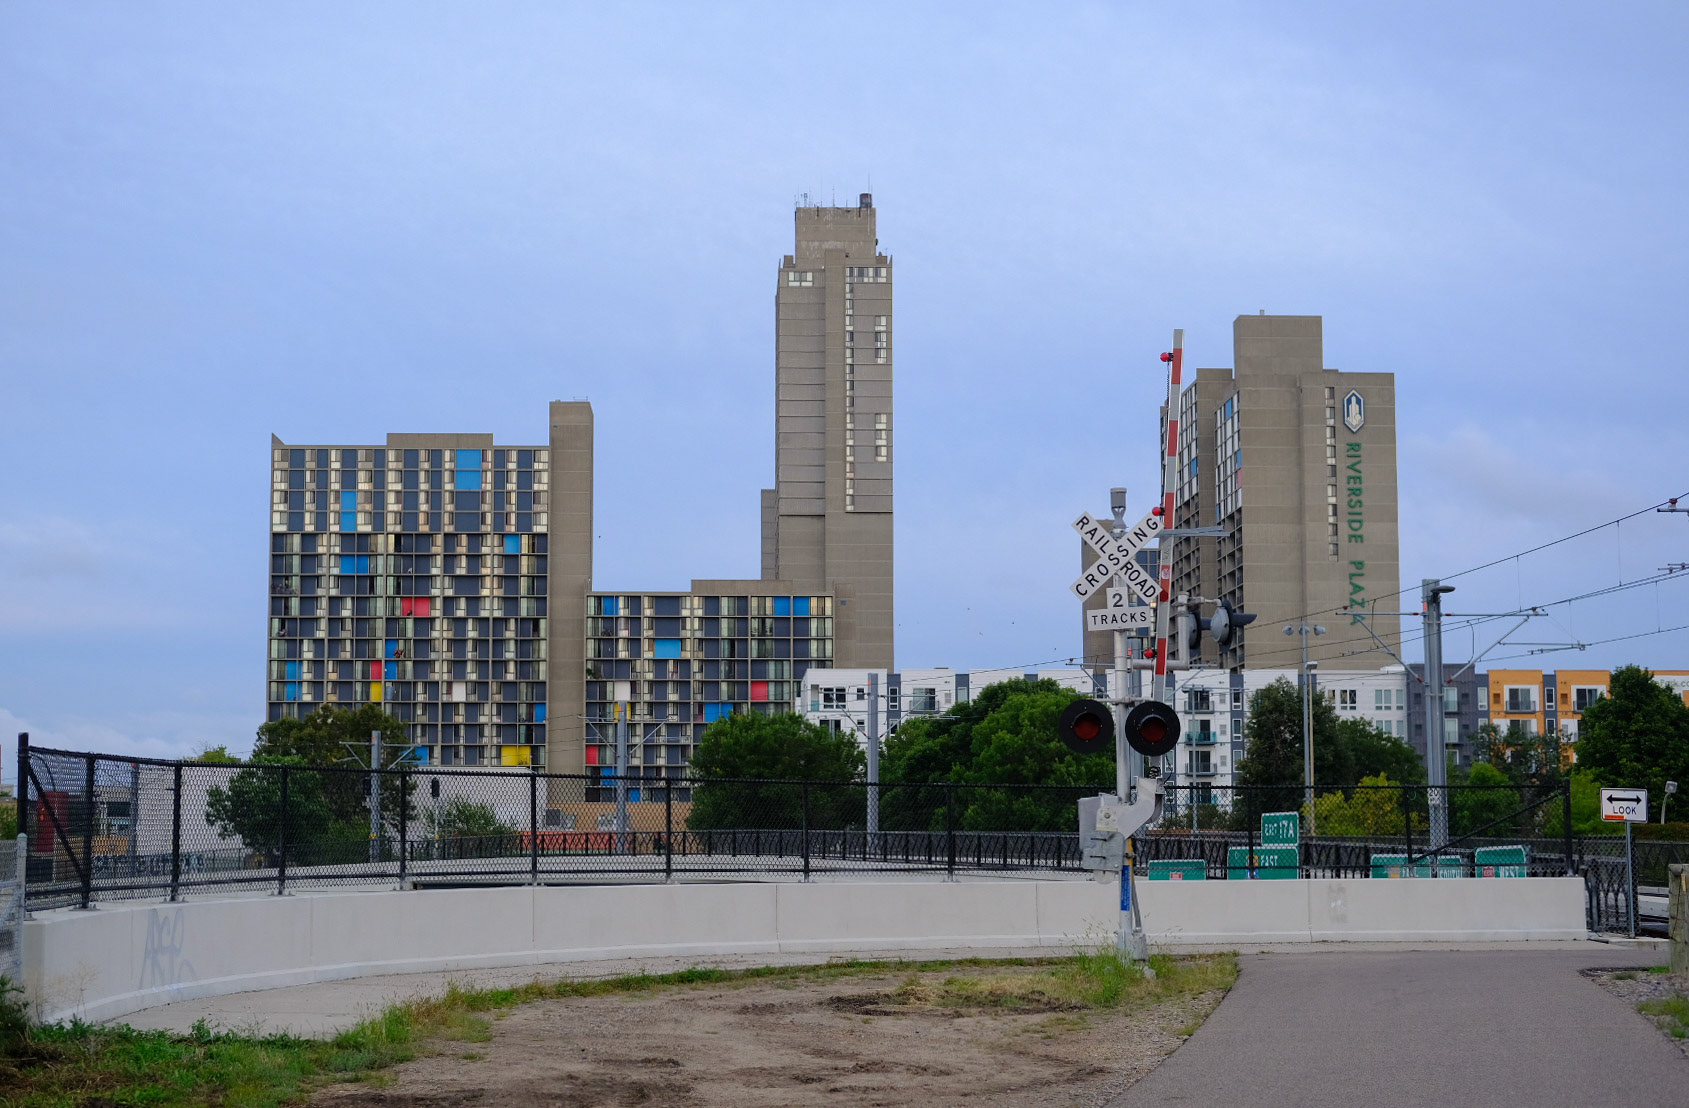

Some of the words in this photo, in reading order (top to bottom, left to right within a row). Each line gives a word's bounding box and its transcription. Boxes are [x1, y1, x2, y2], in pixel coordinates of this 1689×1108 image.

[1346, 442, 1364, 544] RIVERSIDE
[1075, 517, 1159, 597] CROSSING
[1112, 592, 1124, 608] 2
[1349, 560, 1366, 626] PLAZA
[1092, 611, 1147, 625] TRACKS
[1612, 806, 1637, 815] LOOK
[1279, 820, 1295, 839] 17A
